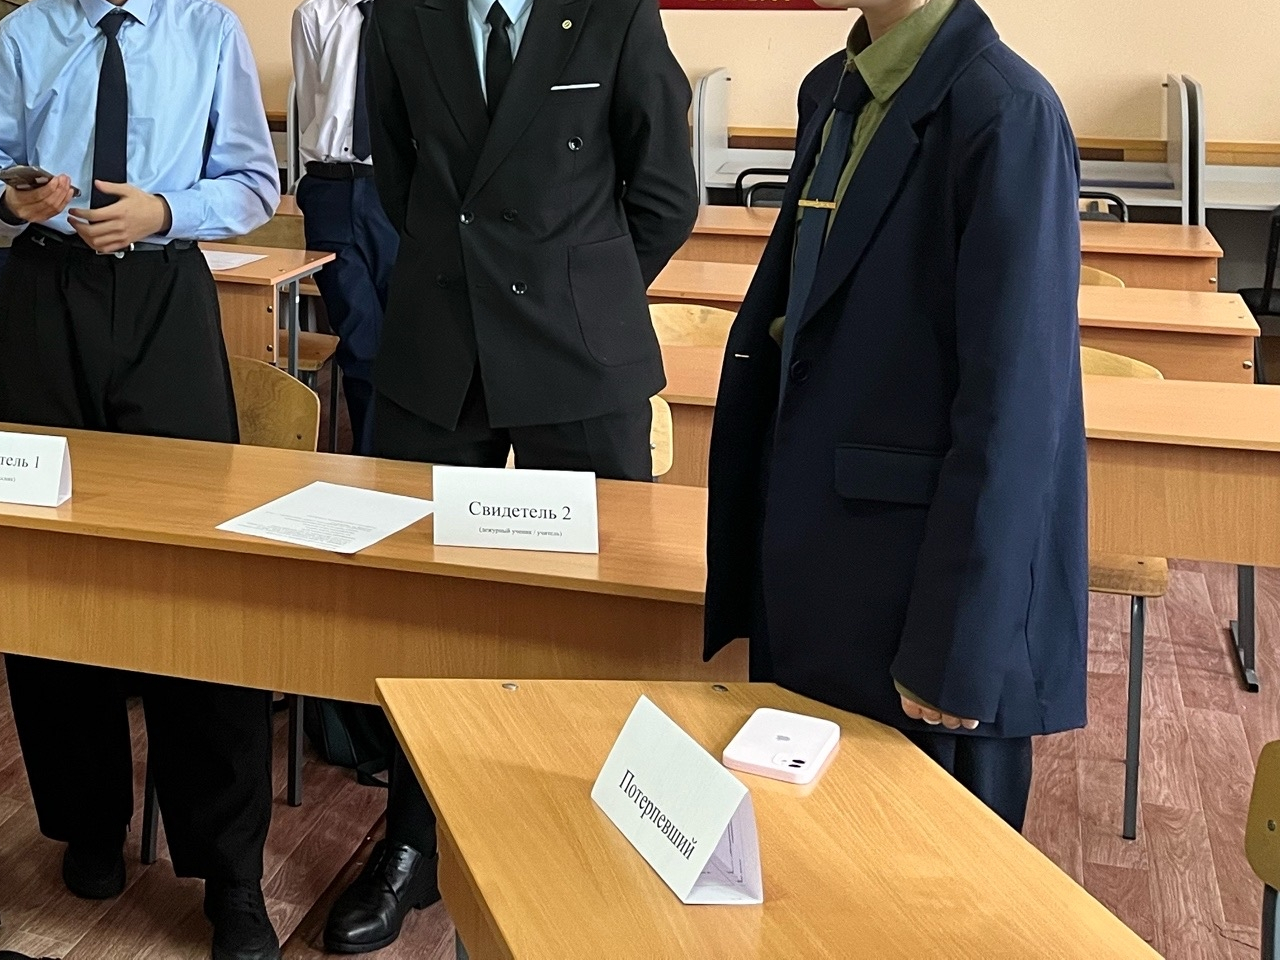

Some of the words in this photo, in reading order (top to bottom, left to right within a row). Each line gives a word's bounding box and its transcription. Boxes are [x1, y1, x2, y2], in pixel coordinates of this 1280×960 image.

[34, 455, 40, 469] 1
[468, 500, 557, 520] Свидетель
[562, 506, 572, 521] 2
[619, 769, 698, 860] Потерпевший
